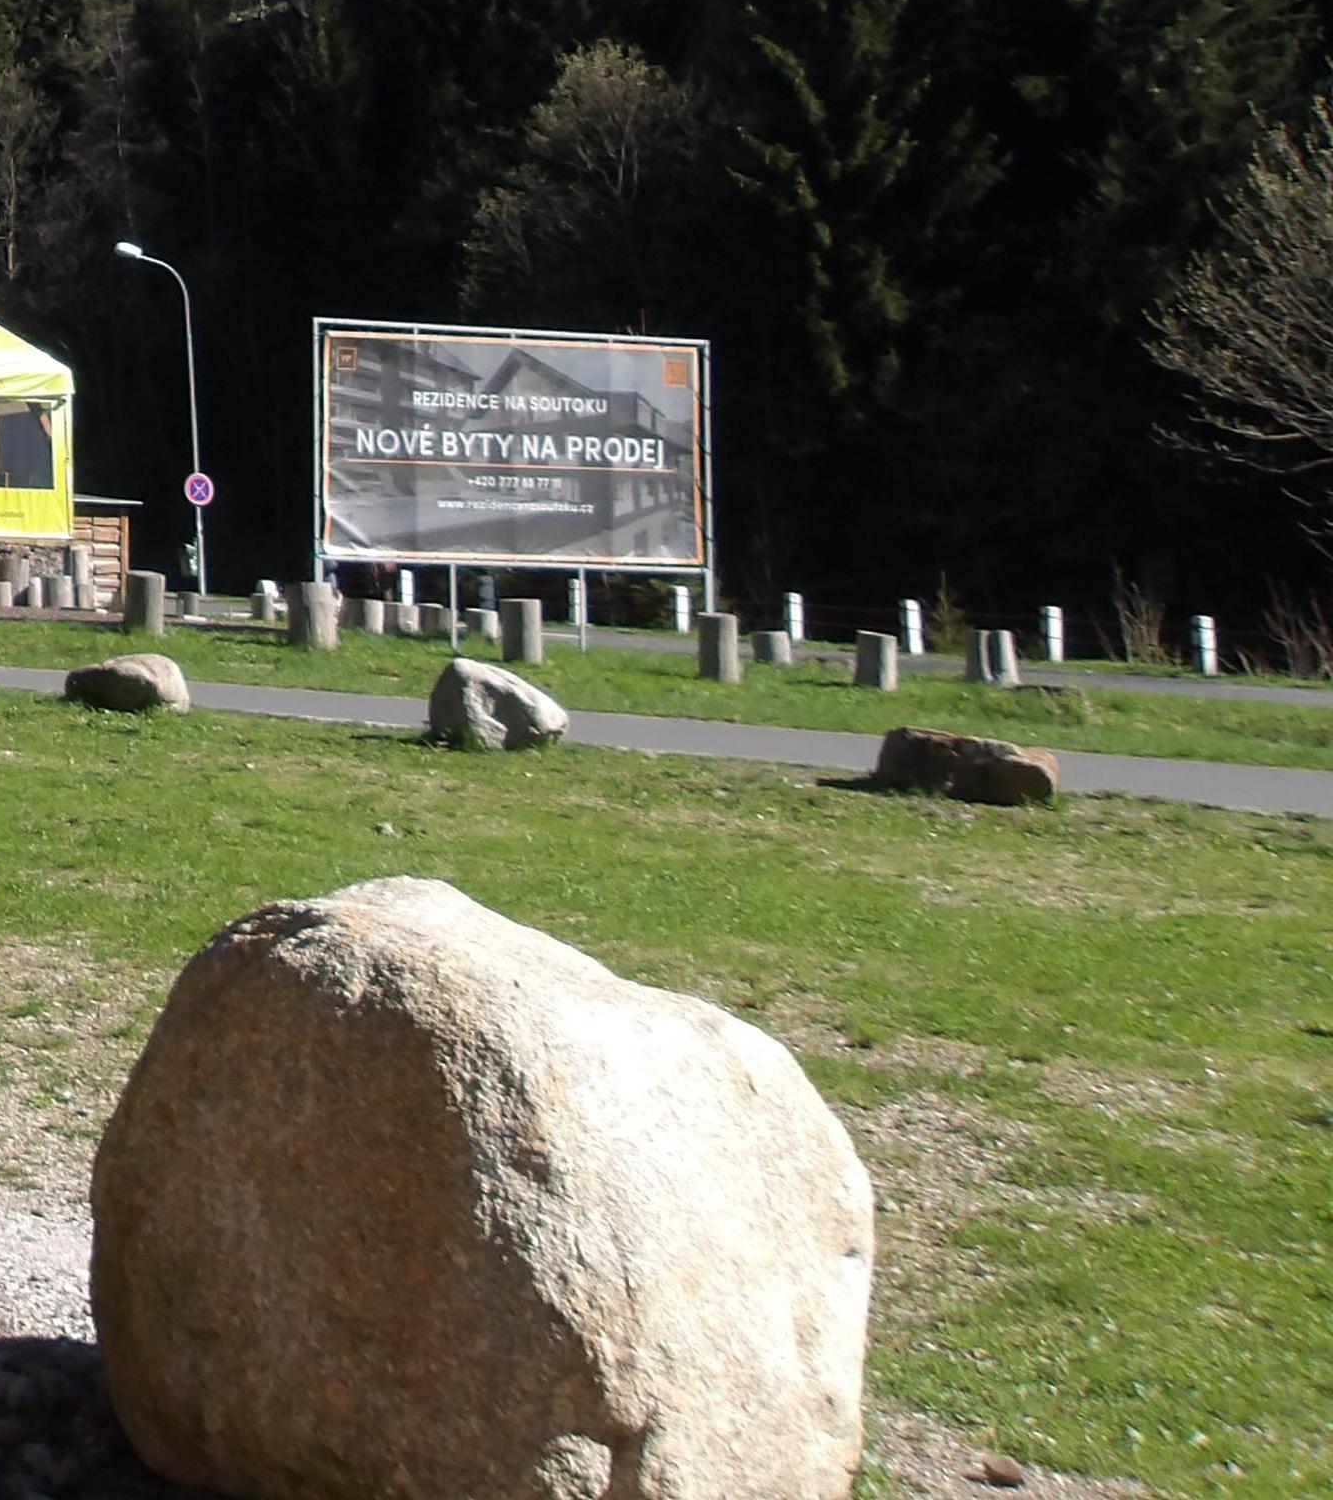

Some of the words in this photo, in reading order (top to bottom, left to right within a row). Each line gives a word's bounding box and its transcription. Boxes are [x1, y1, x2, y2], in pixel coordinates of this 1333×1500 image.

[412, 390, 501, 410] REZIDENCE
[504, 394, 527, 412] NA
[528, 395, 608, 414] SOUTOKU
[356, 422, 434, 456] NOVÉ
[442, 430, 514, 458] BYTY
[521, 433, 559, 460] NA
[566, 434, 665, 470] PRODEJ
